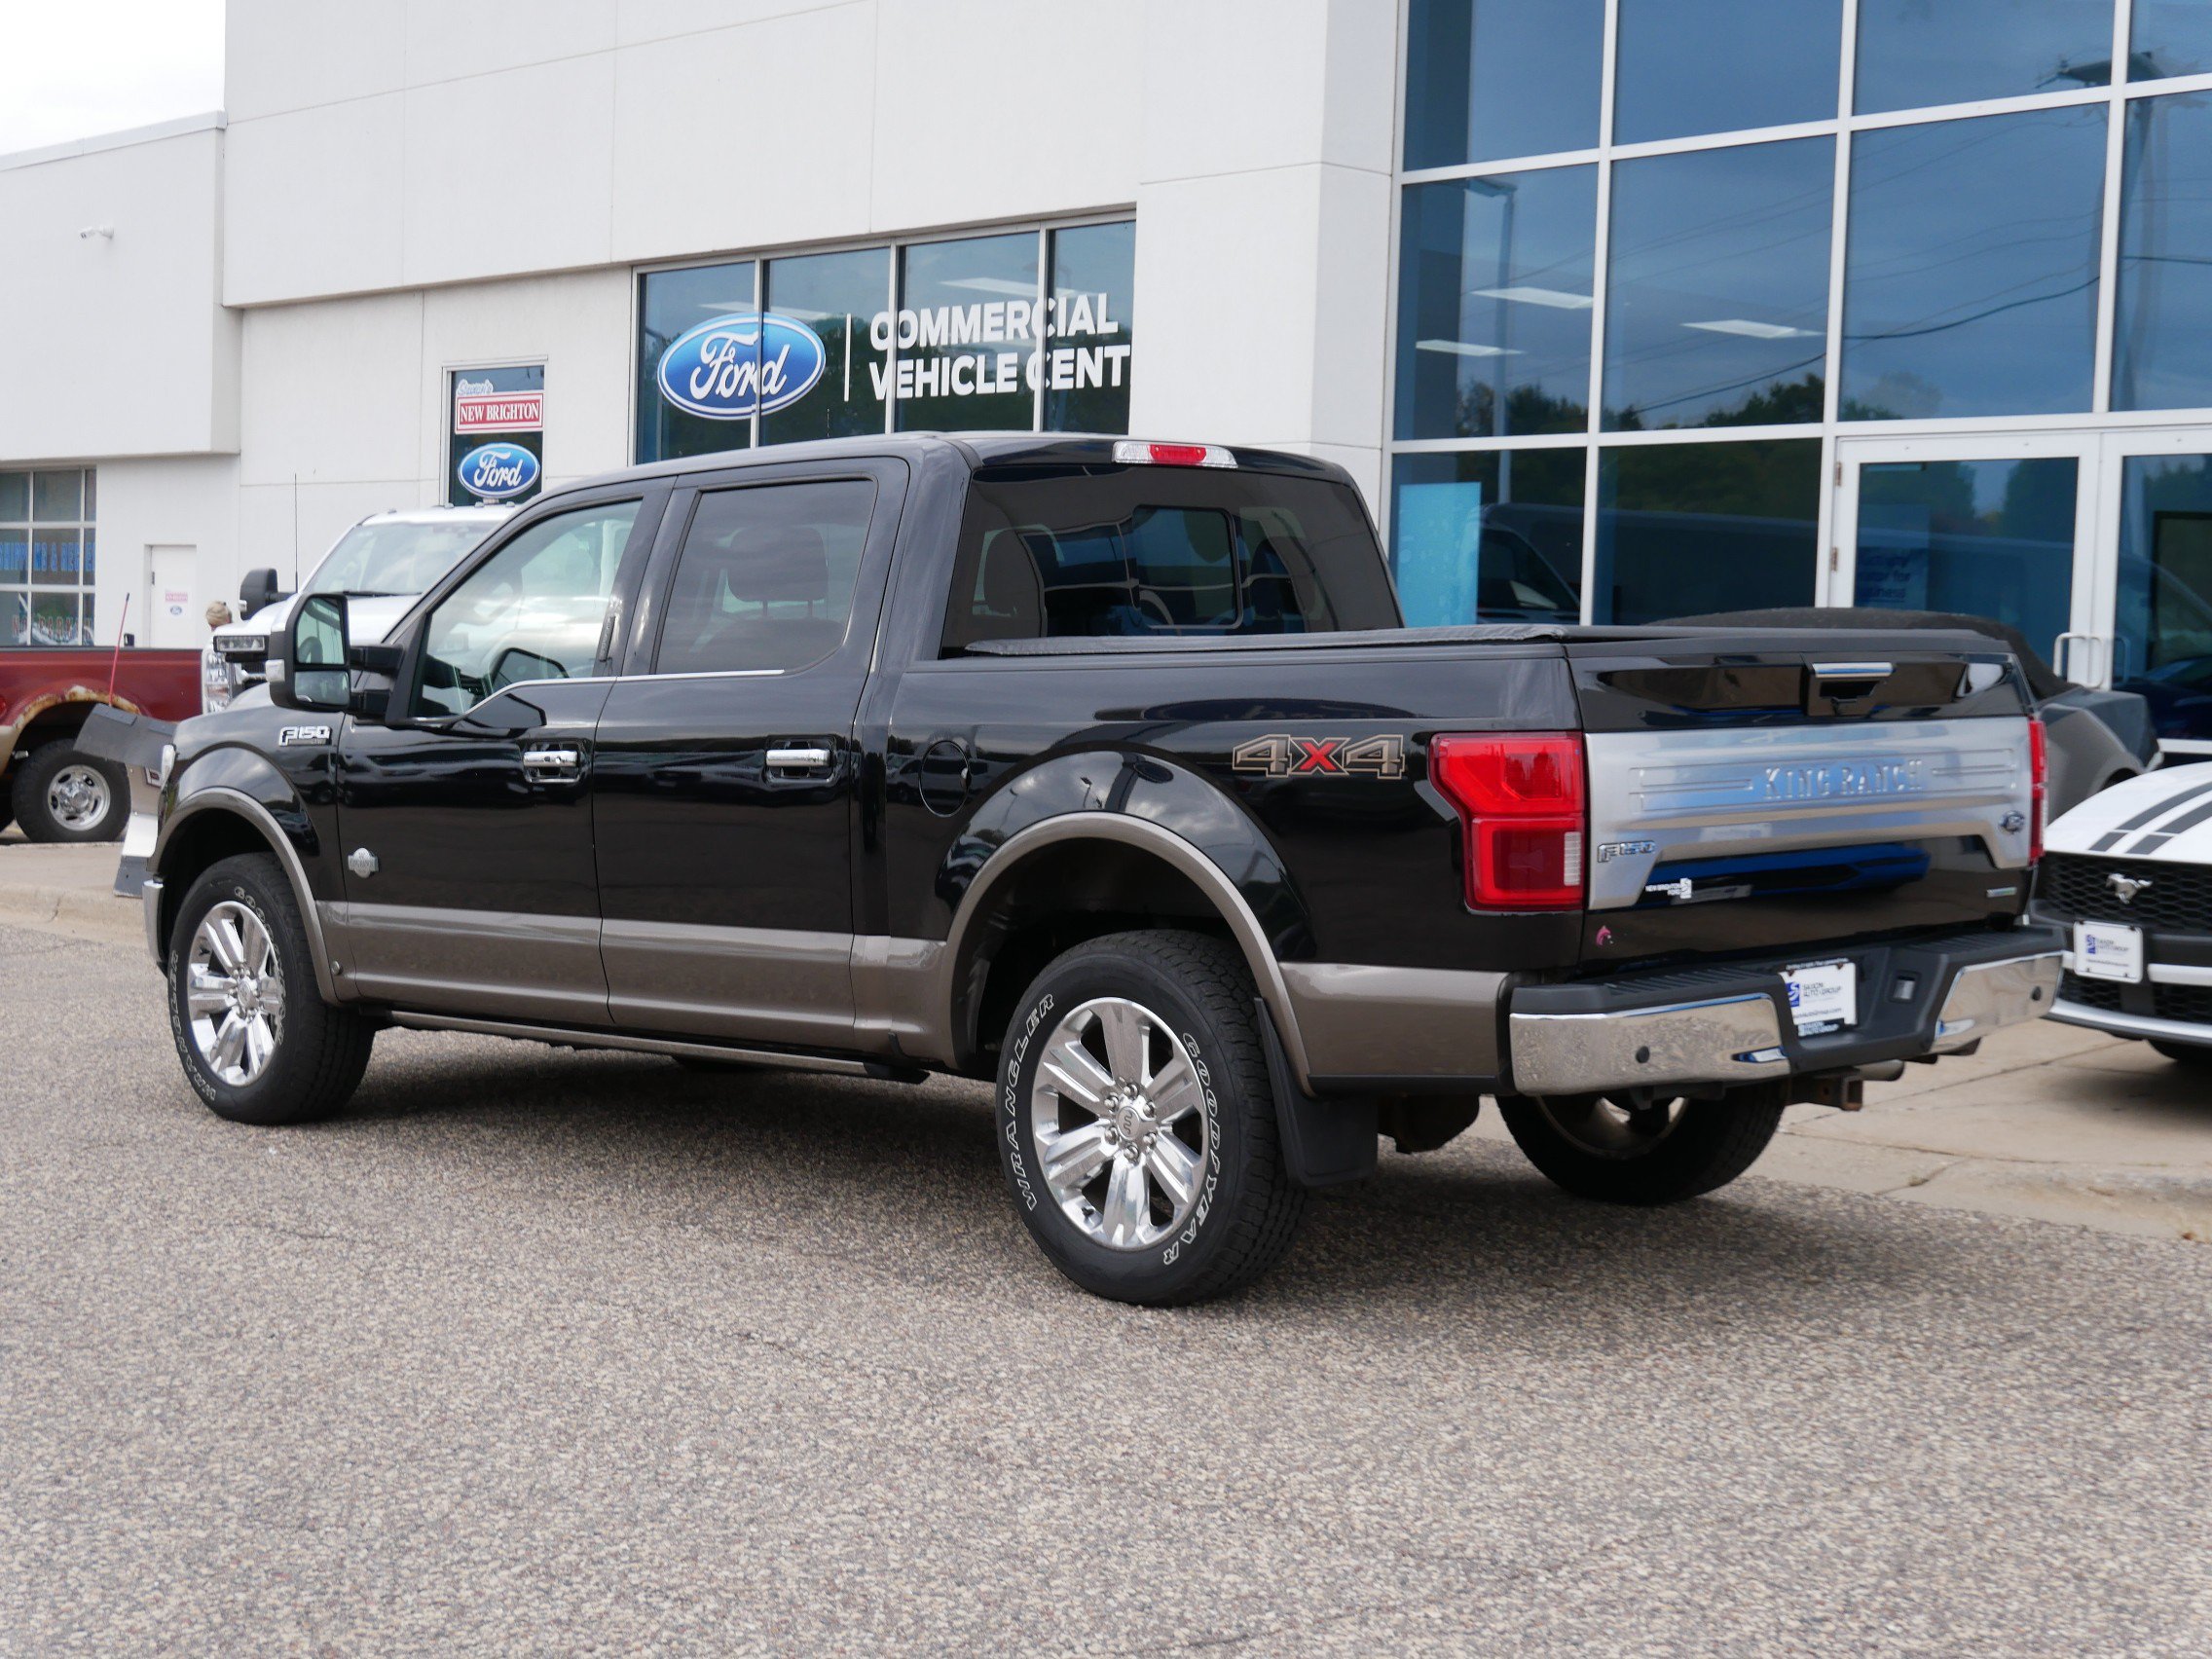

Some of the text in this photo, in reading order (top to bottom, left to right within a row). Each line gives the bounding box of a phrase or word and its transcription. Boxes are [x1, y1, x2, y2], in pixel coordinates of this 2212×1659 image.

[869, 293, 1120, 351] COMMERCIAL
[689, 329, 791, 399] Ford
[869, 352, 1018, 401] VEHICLE
[461, 401, 539, 423] NEW BRIGHTON
[473, 450, 524, 488] Ford
[1233, 734, 1405, 779] 4X4
[1764, 759, 1923, 799] KING RANCH
[1005, 993, 1054, 1211] WRANGLER
[1163, 1032, 1221, 1265] GOODYEAR
